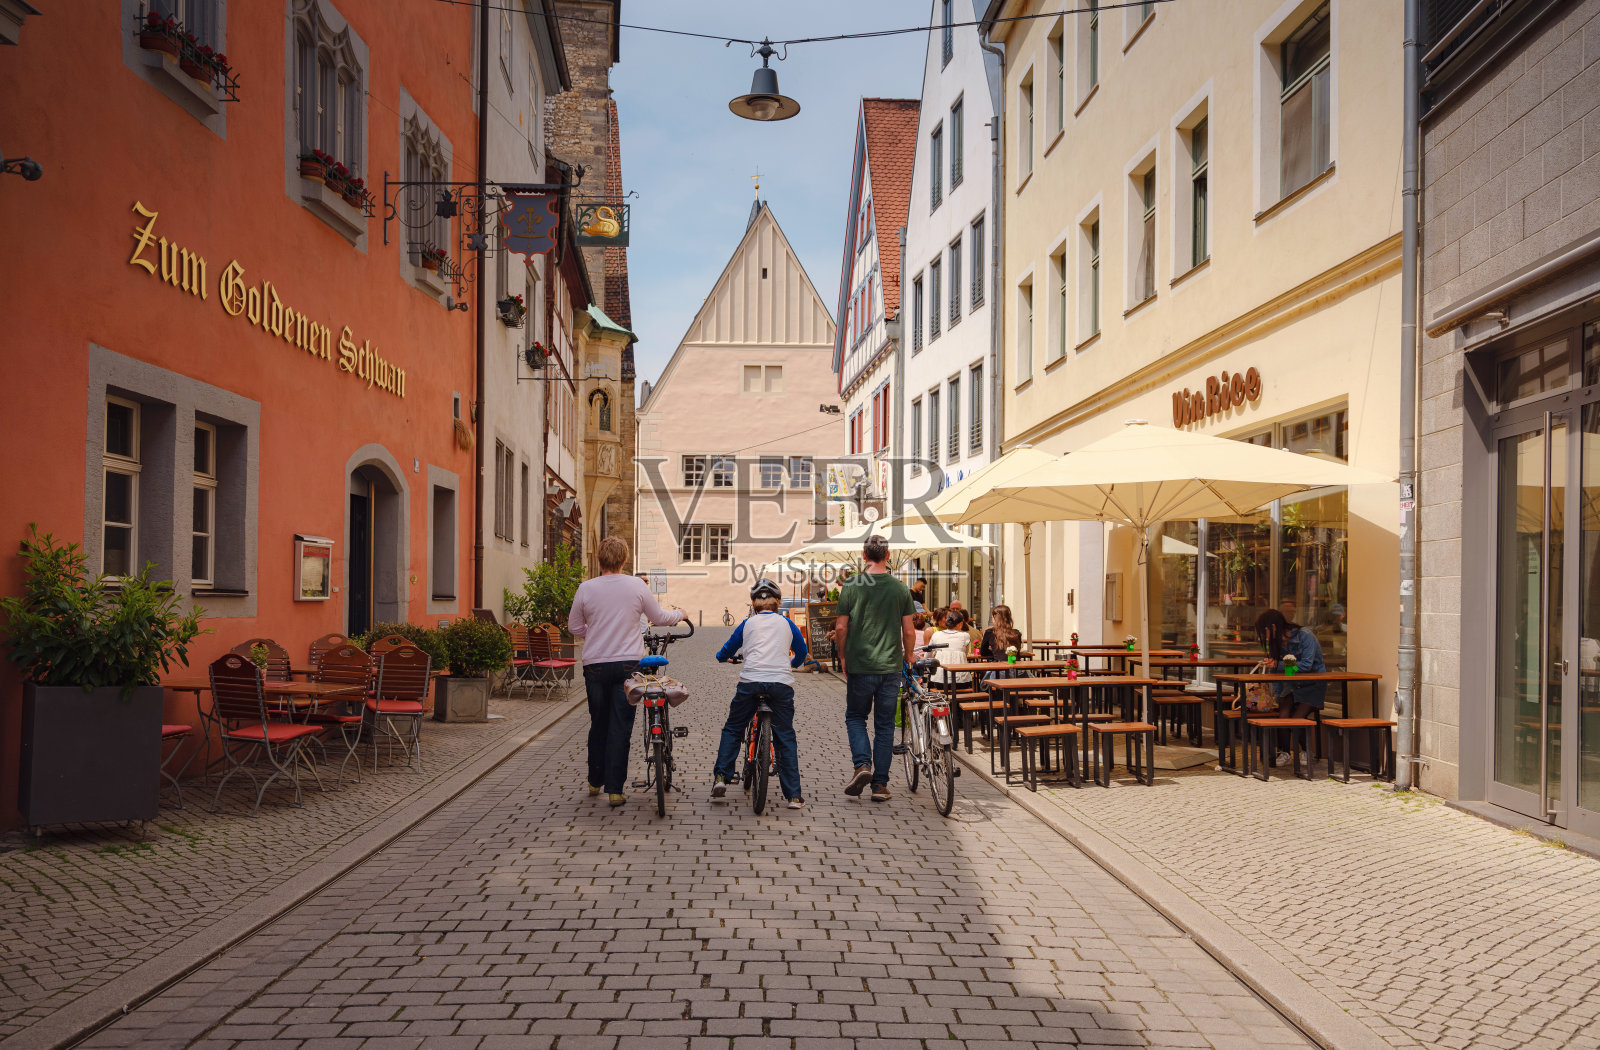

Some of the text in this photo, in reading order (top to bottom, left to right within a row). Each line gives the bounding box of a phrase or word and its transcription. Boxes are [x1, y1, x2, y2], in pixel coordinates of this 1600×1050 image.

[129, 201, 406, 398] Zum Goldenen Schwan
